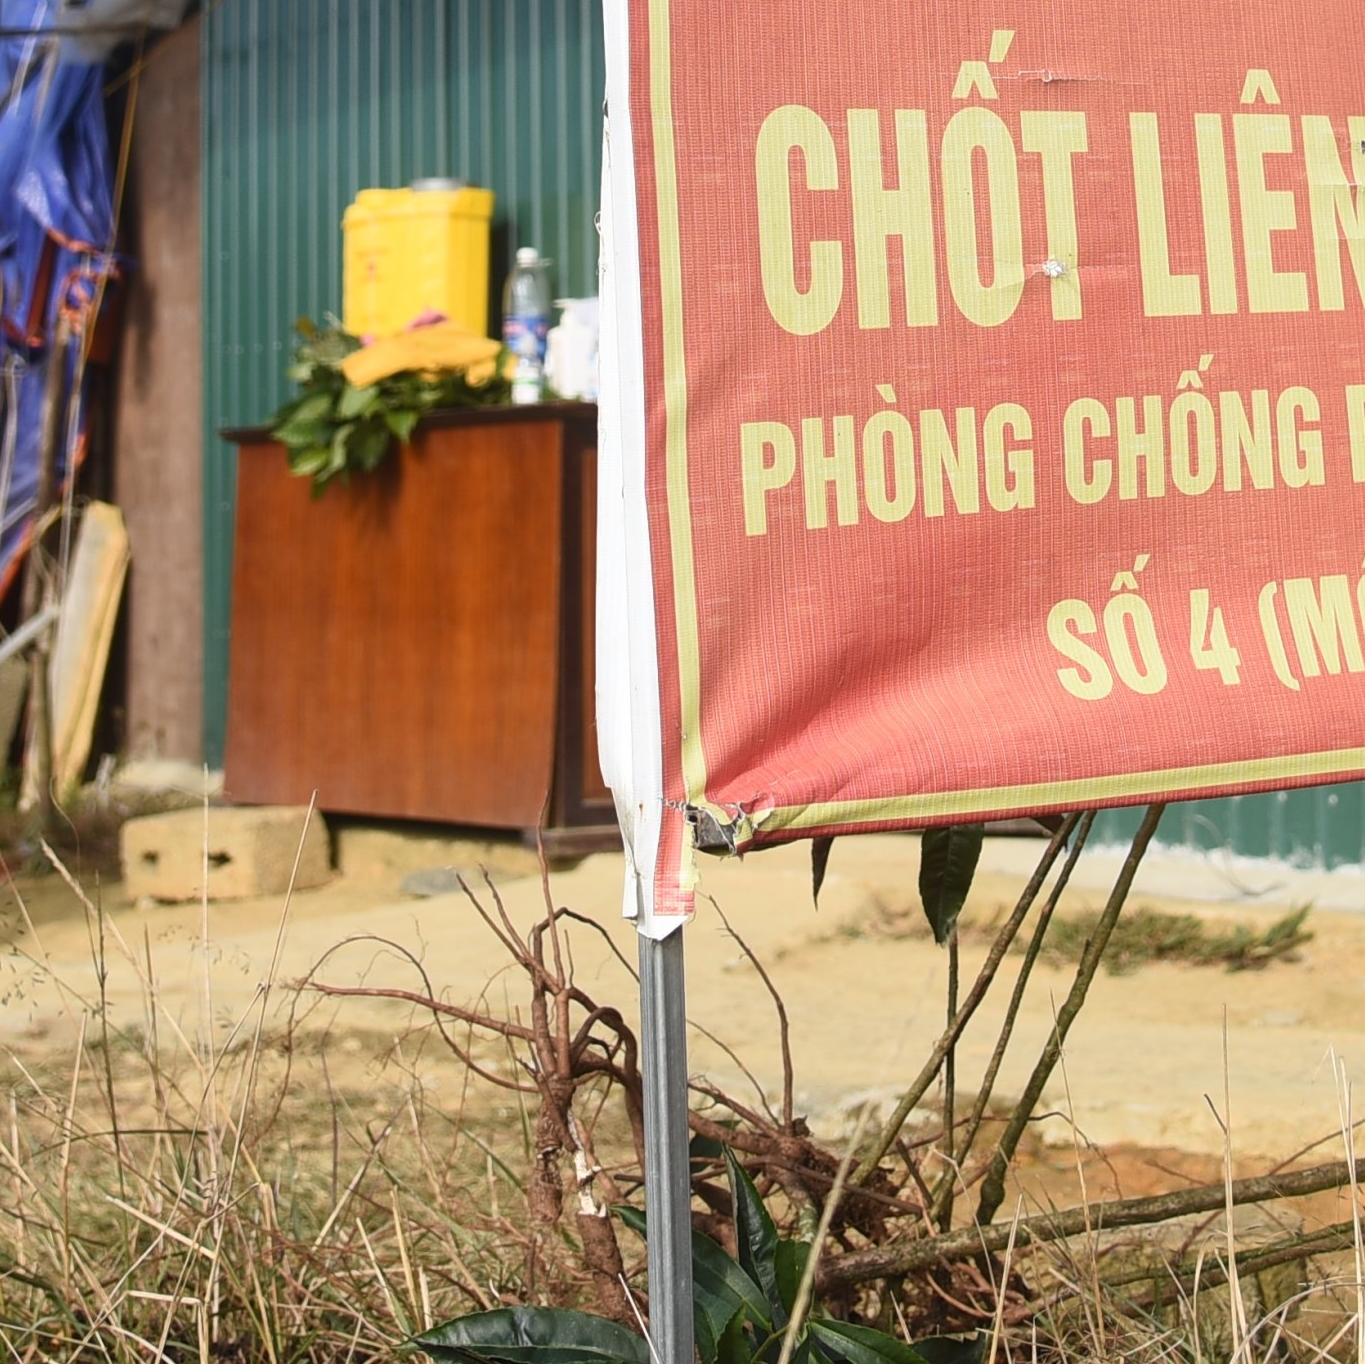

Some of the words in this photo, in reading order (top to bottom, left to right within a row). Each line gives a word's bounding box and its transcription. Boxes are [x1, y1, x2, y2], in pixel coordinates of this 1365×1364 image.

[756, 30, 1088, 335] CHỐT
[741, 385, 1034, 535] PHÒNG
[1064, 355, 1324, 503] CHỐNG
[1048, 555, 1167, 700] SỐ
[1191, 589, 1240, 684] 4
